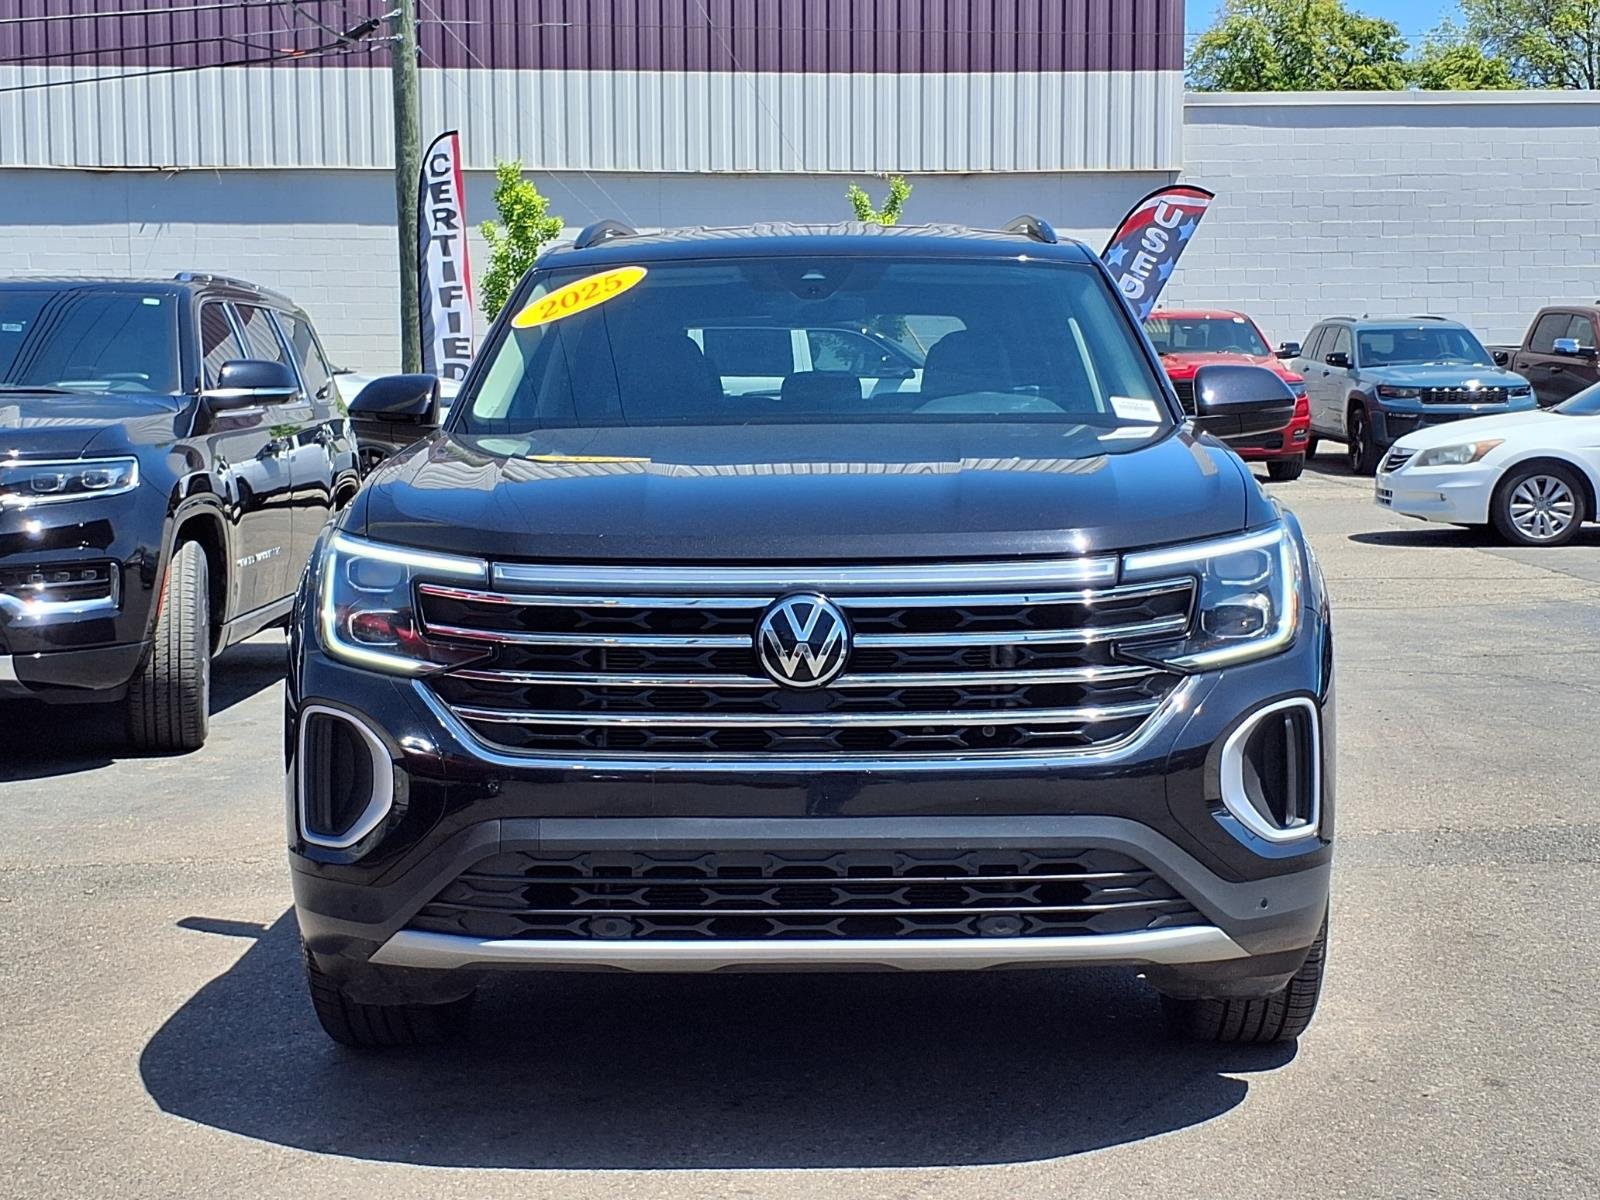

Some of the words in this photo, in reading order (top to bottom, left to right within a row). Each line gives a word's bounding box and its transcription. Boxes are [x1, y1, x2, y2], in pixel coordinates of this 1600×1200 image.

[429, 153, 471, 381] CERTIFIED
[1117, 200, 1184, 299] USED
[540, 274, 622, 319] 2025
[760, 597, 845, 681] VW
